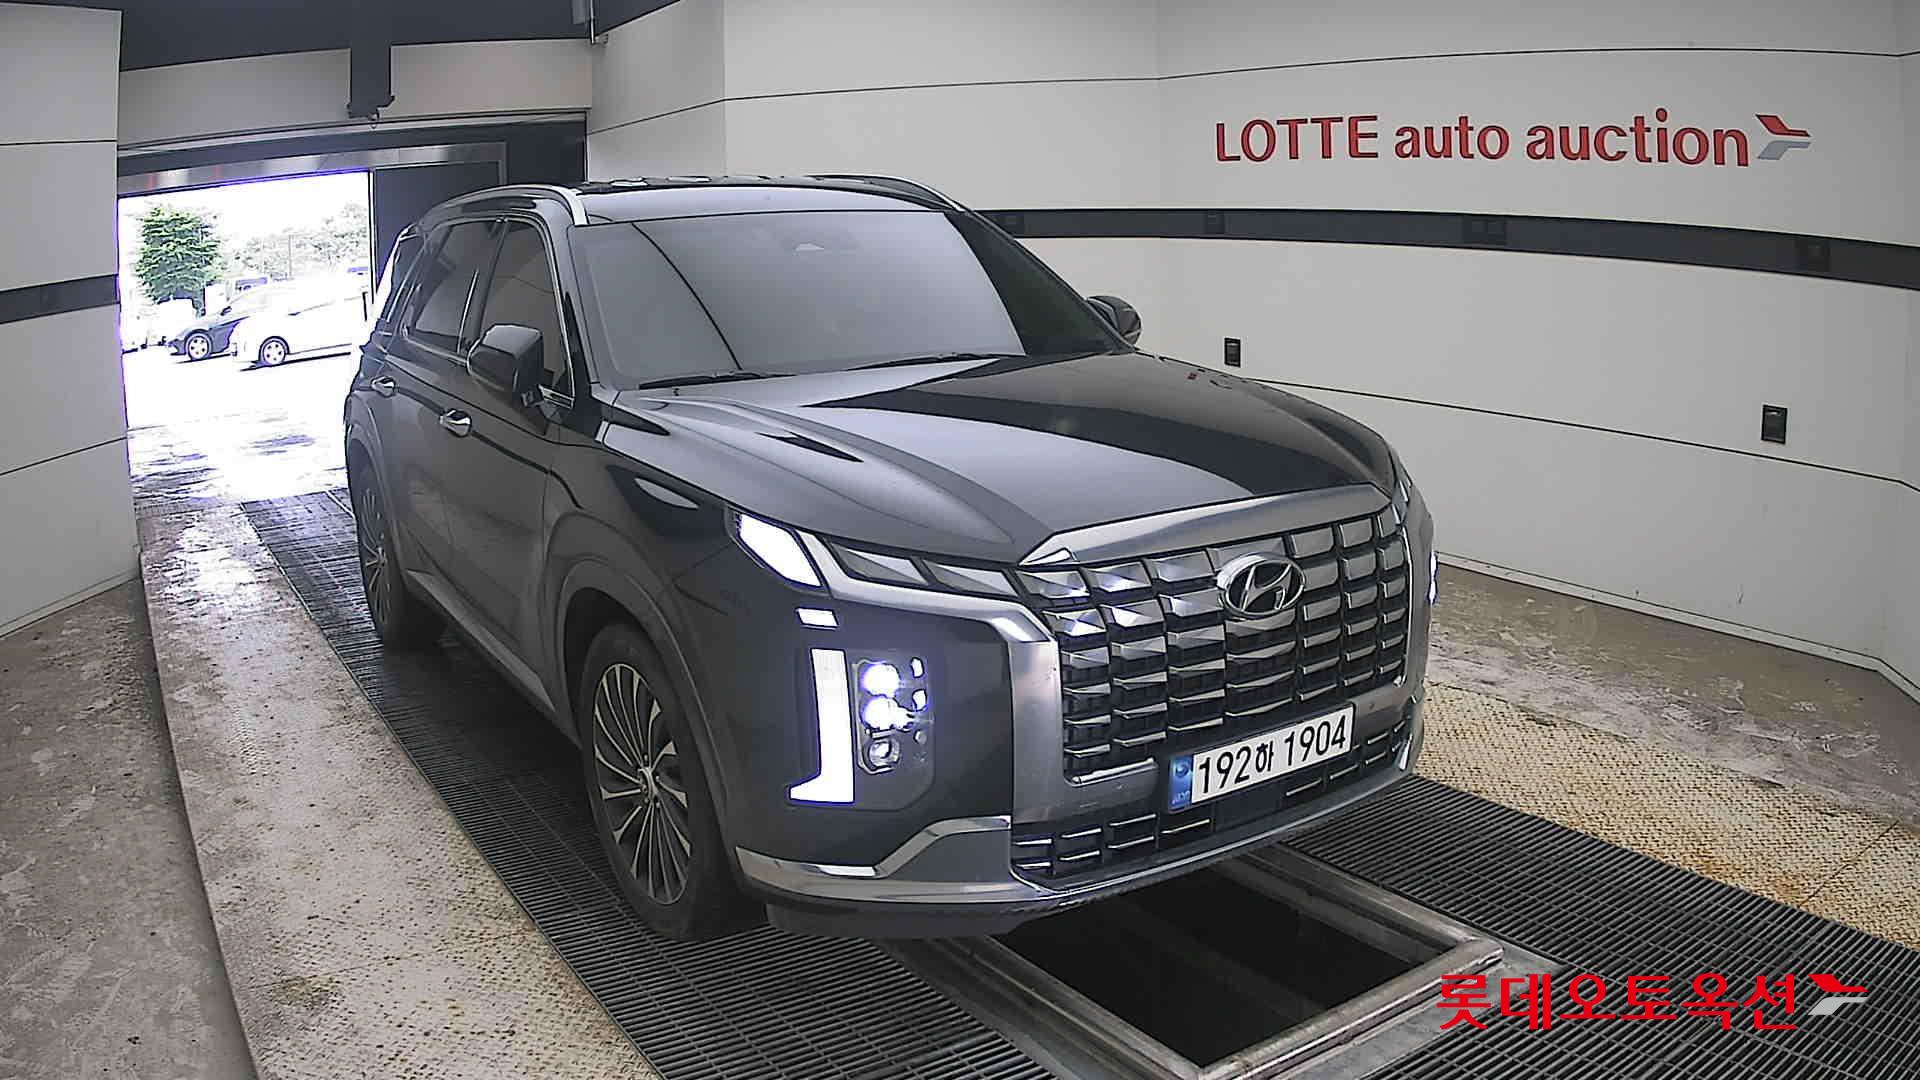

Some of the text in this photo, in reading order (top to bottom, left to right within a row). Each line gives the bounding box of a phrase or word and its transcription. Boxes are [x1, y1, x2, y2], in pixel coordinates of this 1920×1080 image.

[1216, 108, 1750, 166] LOTTE auto auction
[1199, 715, 1346, 794] 192하 1904
